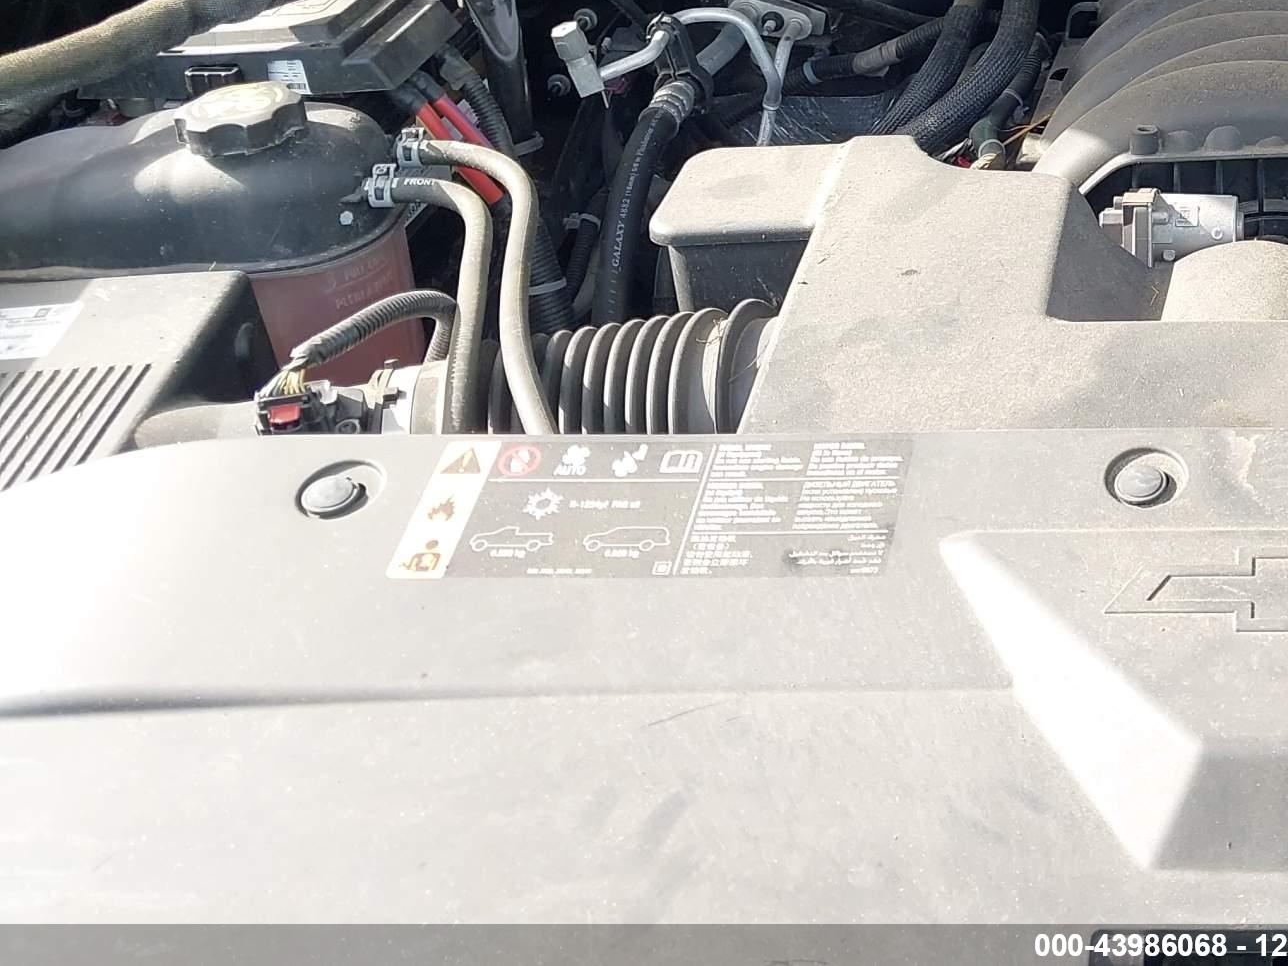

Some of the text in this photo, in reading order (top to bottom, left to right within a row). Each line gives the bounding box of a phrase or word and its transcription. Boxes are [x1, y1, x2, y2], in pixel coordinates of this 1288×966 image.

[403, 177, 436, 186] FRONT
[611, 221, 625, 267] GALAXY
[553, 463, 587, 476] AUTO
